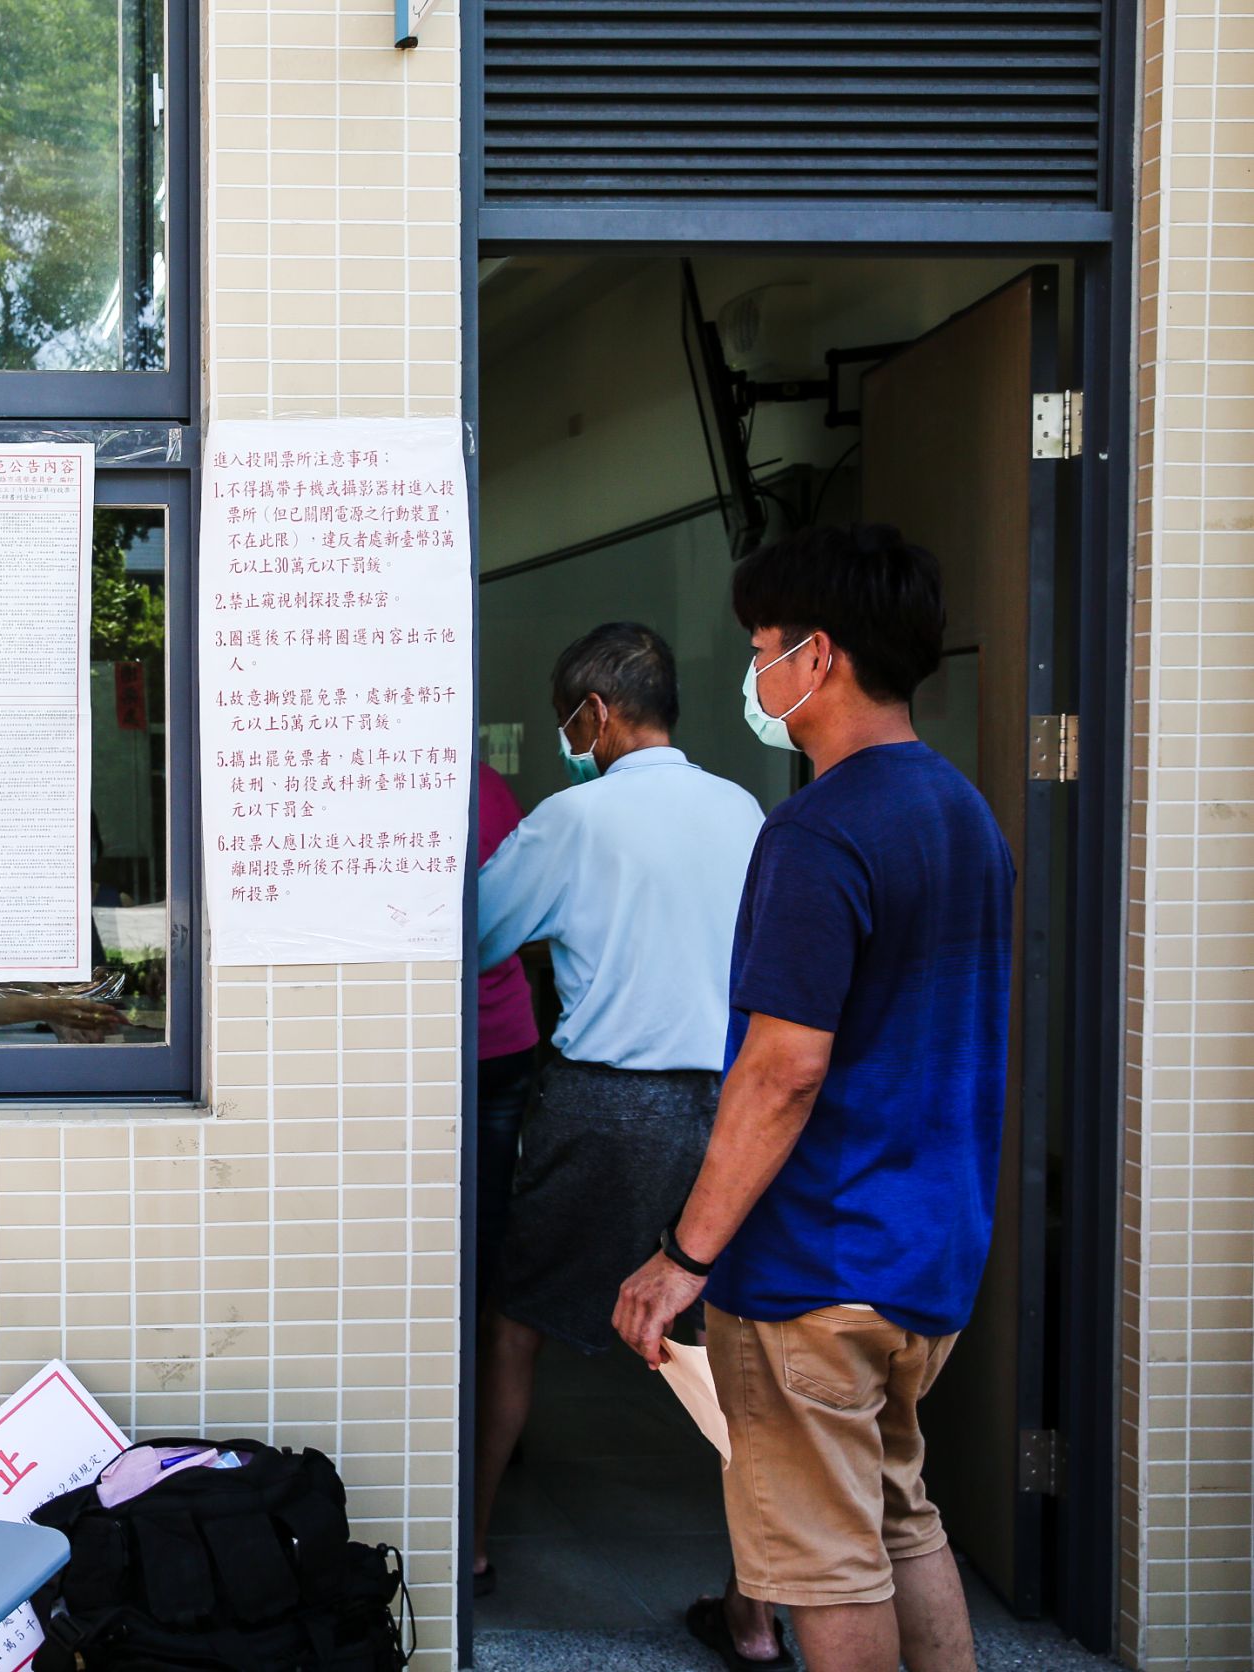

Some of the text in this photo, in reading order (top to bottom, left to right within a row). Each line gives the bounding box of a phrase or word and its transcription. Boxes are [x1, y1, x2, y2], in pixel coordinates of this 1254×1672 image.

[213, 449, 389, 468] 進入投開票所注意事項：
[214, 479, 455, 500] 1.不得攜帶手機或攝影器材進入投
[228, 556, 392, 576] 元以上30萬元以下罰鍰。
[215, 590, 401, 611] 2.禁止窺視刺探投票秘密。
[215, 627, 456, 648] 3.圈選後不得將圈選內容出示他
[229, 656, 257, 671] 人。
[230, 713, 402, 732] 元以上5萬元以下罰鍰。
[231, 772, 457, 793] 徒刑、拘役或科新臺幣1萬5千
[231, 800, 327, 819] 元以下罰金。
[231, 856, 458, 877] 離開投票所後不得再次進入投票
[231, 884, 291, 903] 所投票。
